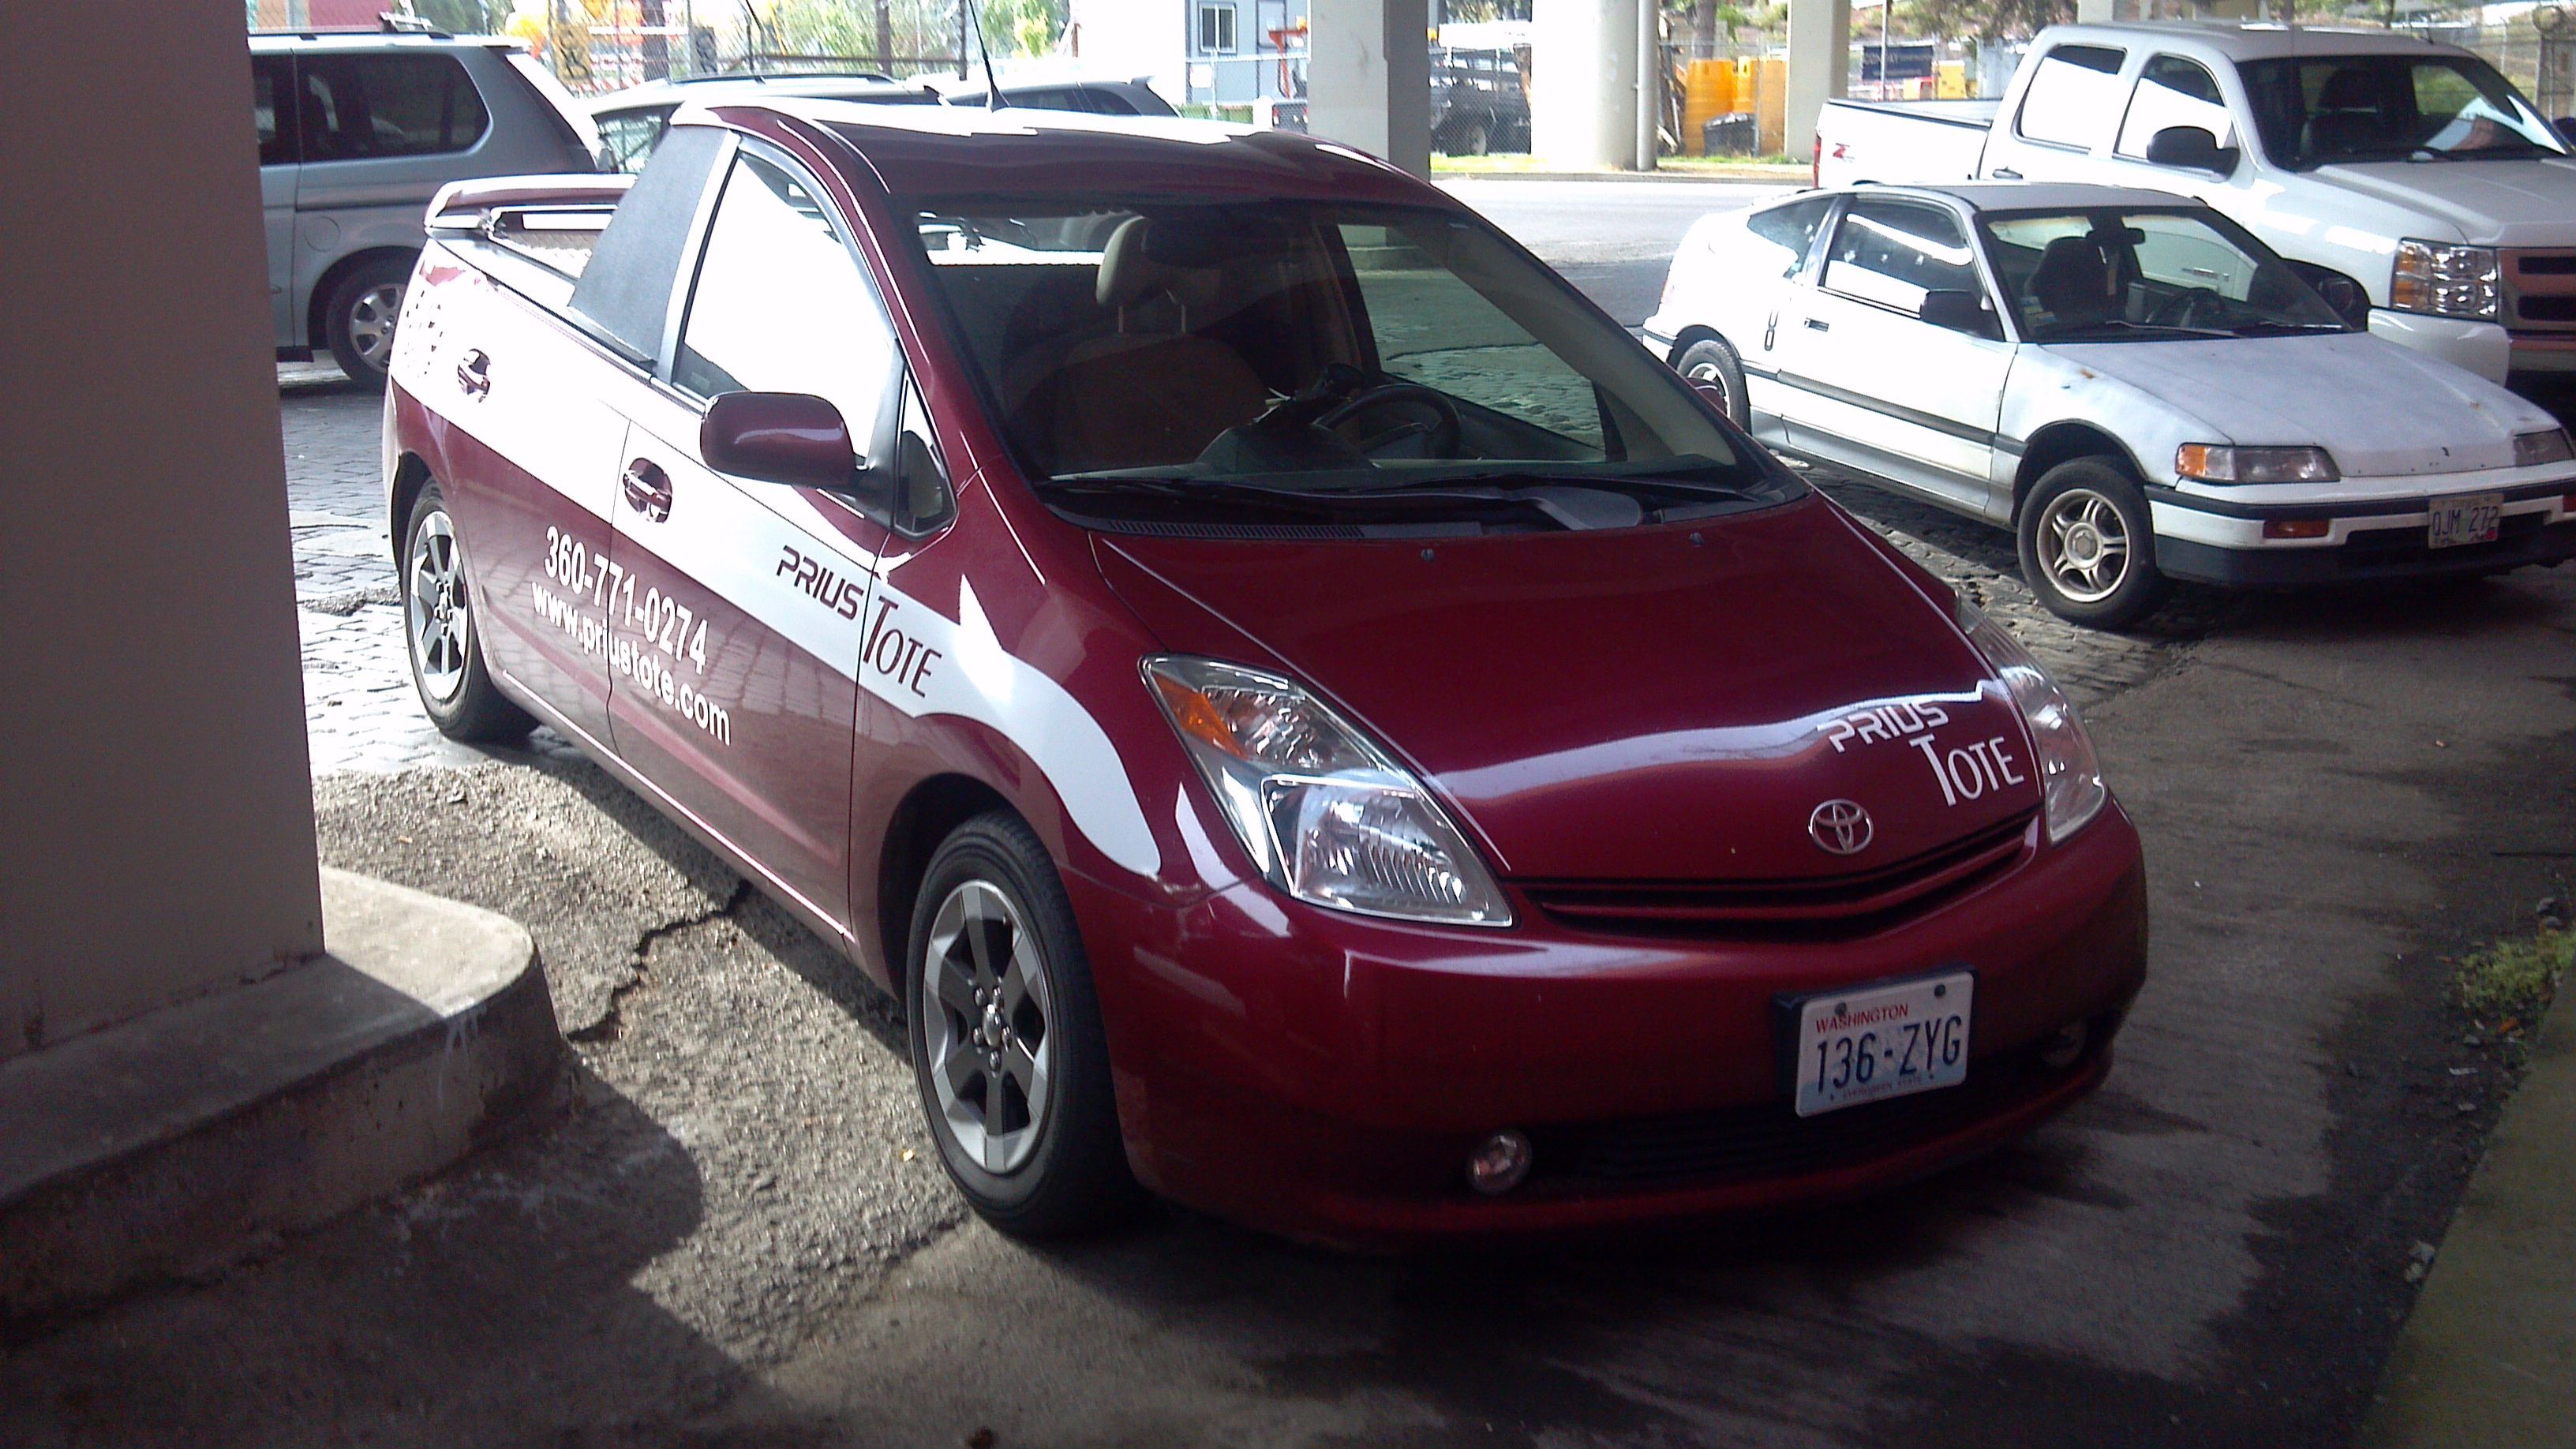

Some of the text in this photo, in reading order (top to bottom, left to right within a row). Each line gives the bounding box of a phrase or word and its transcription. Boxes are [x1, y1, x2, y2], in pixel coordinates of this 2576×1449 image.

[545, 526, 709, 675] 360-771-0274
[776, 545, 864, 620] PRIUS
[532, 581, 731, 745] www.priustote.com
[863, 595, 942, 698] TOTE
[1817, 700, 1949, 753] PRIUS
[1909, 734, 2024, 807] TOTE
[1816, 1003, 1908, 1033] WASHINGTON
